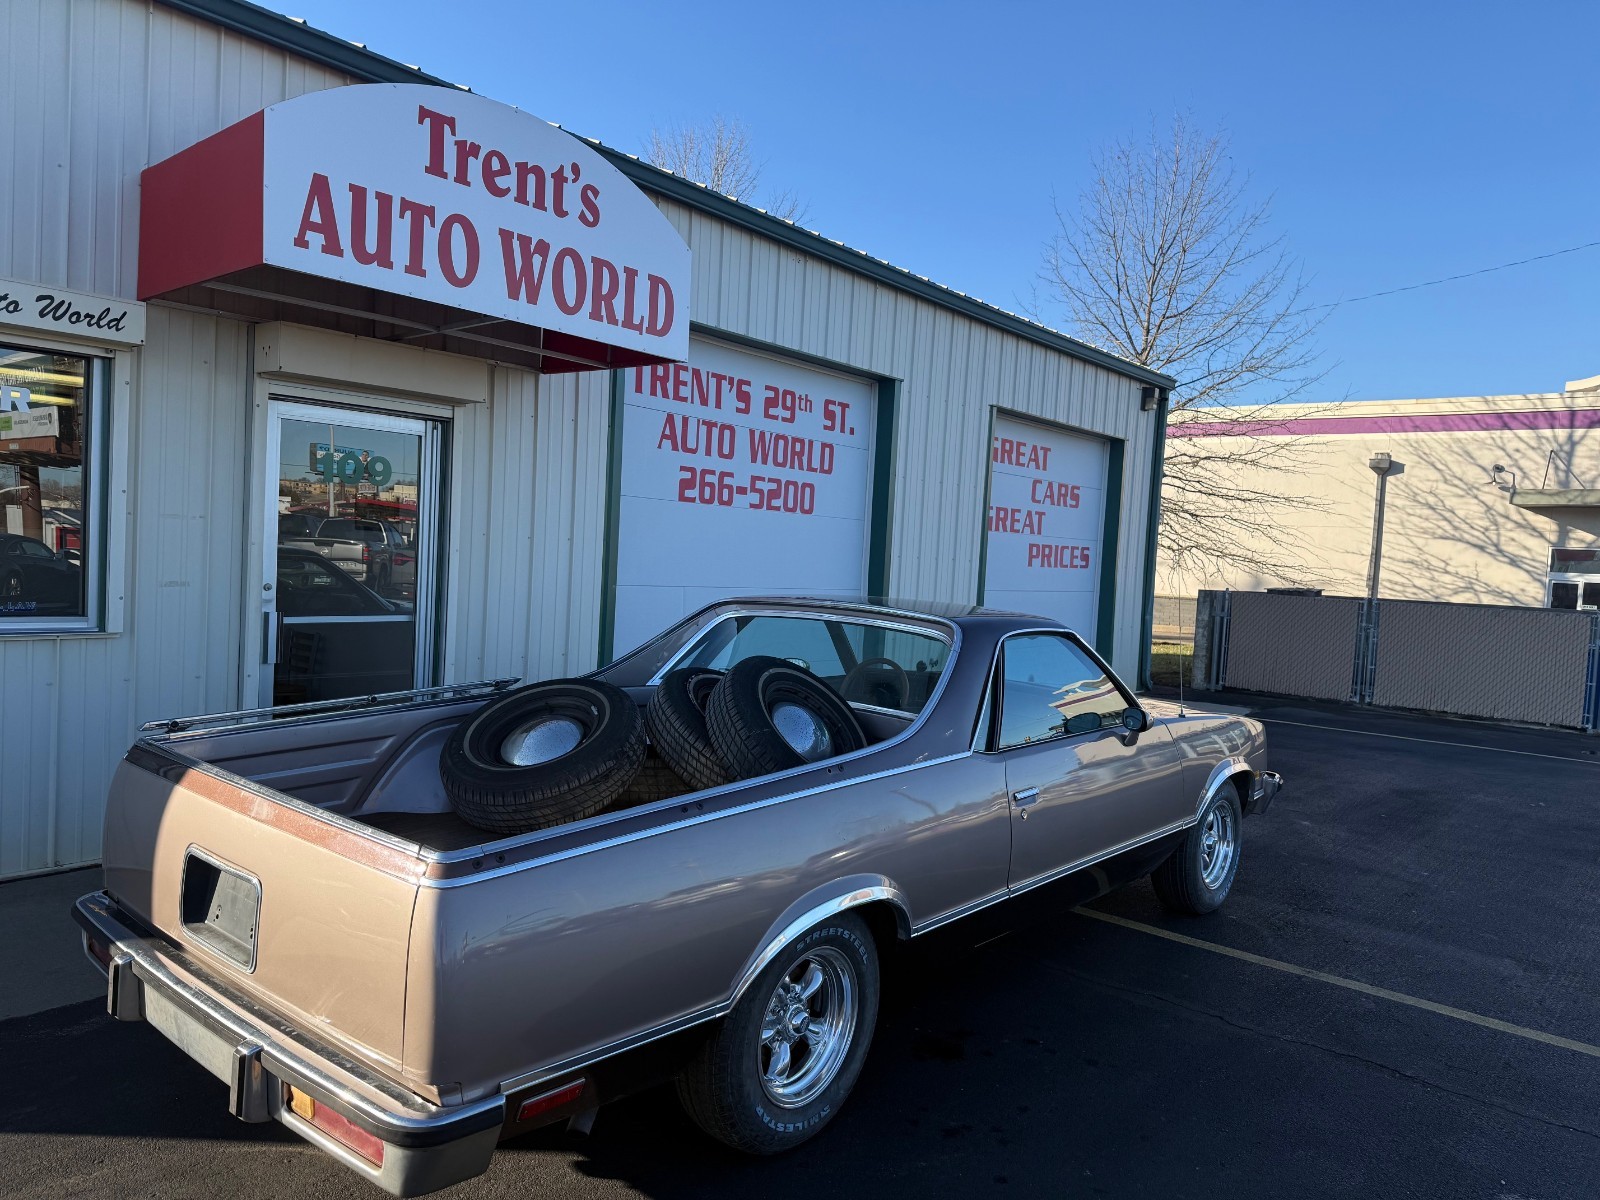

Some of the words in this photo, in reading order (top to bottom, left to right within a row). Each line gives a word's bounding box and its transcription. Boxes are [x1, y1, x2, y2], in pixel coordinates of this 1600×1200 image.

[417, 105, 601, 228] Trent's
[293, 172, 480, 289] AUTO
[498, 227, 676, 338] WORLD
[35, 294, 128, 332] World
[763, 384, 813, 424] 29th
[822, 398, 856, 436] ST.
[656, 412, 737, 461] AUTO
[748, 428, 835, 475] WORLD
[316, 452, 393, 487] 109
[677, 465, 816, 515] 266-5200
[1030, 478, 1081, 509] CARS
[1027, 542, 1091, 570] PRICES
